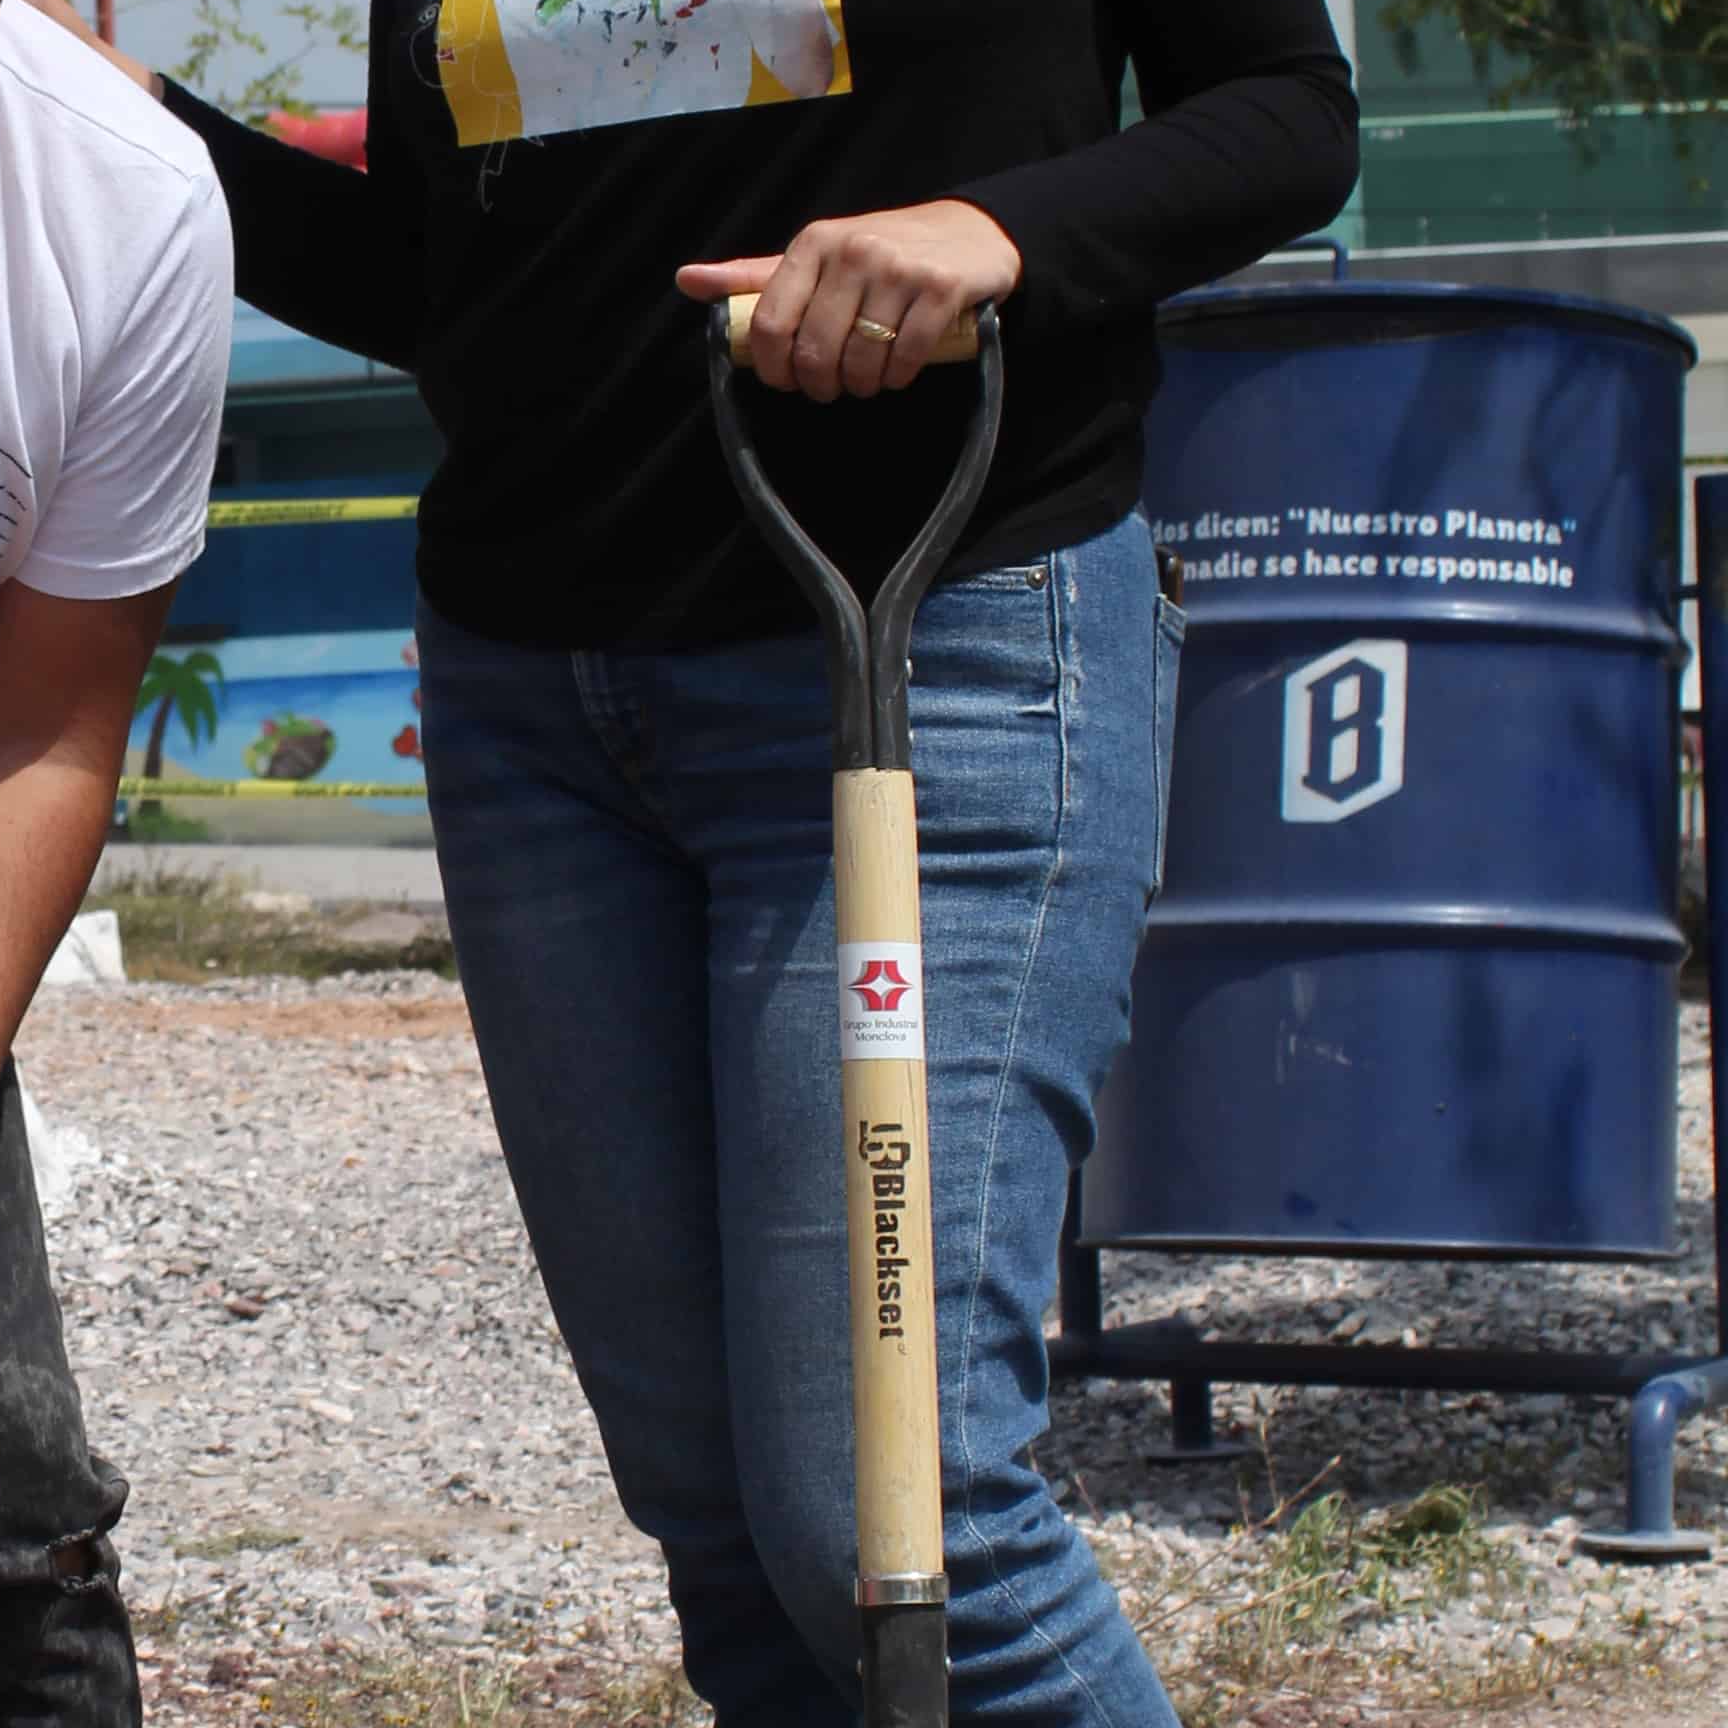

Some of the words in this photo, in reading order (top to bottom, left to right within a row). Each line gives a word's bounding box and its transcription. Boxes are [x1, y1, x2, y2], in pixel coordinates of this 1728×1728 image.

[1194, 511, 1280, 541] dicen:
[1183, 551, 1258, 581] nadie
[1264, 555, 1298, 577] se
[1305, 548, 1378, 577] hace
[1385, 556, 1574, 589] responsable
[855, 1031, 907, 1042] Monclova
[872, 1173, 911, 1340] Blackset
